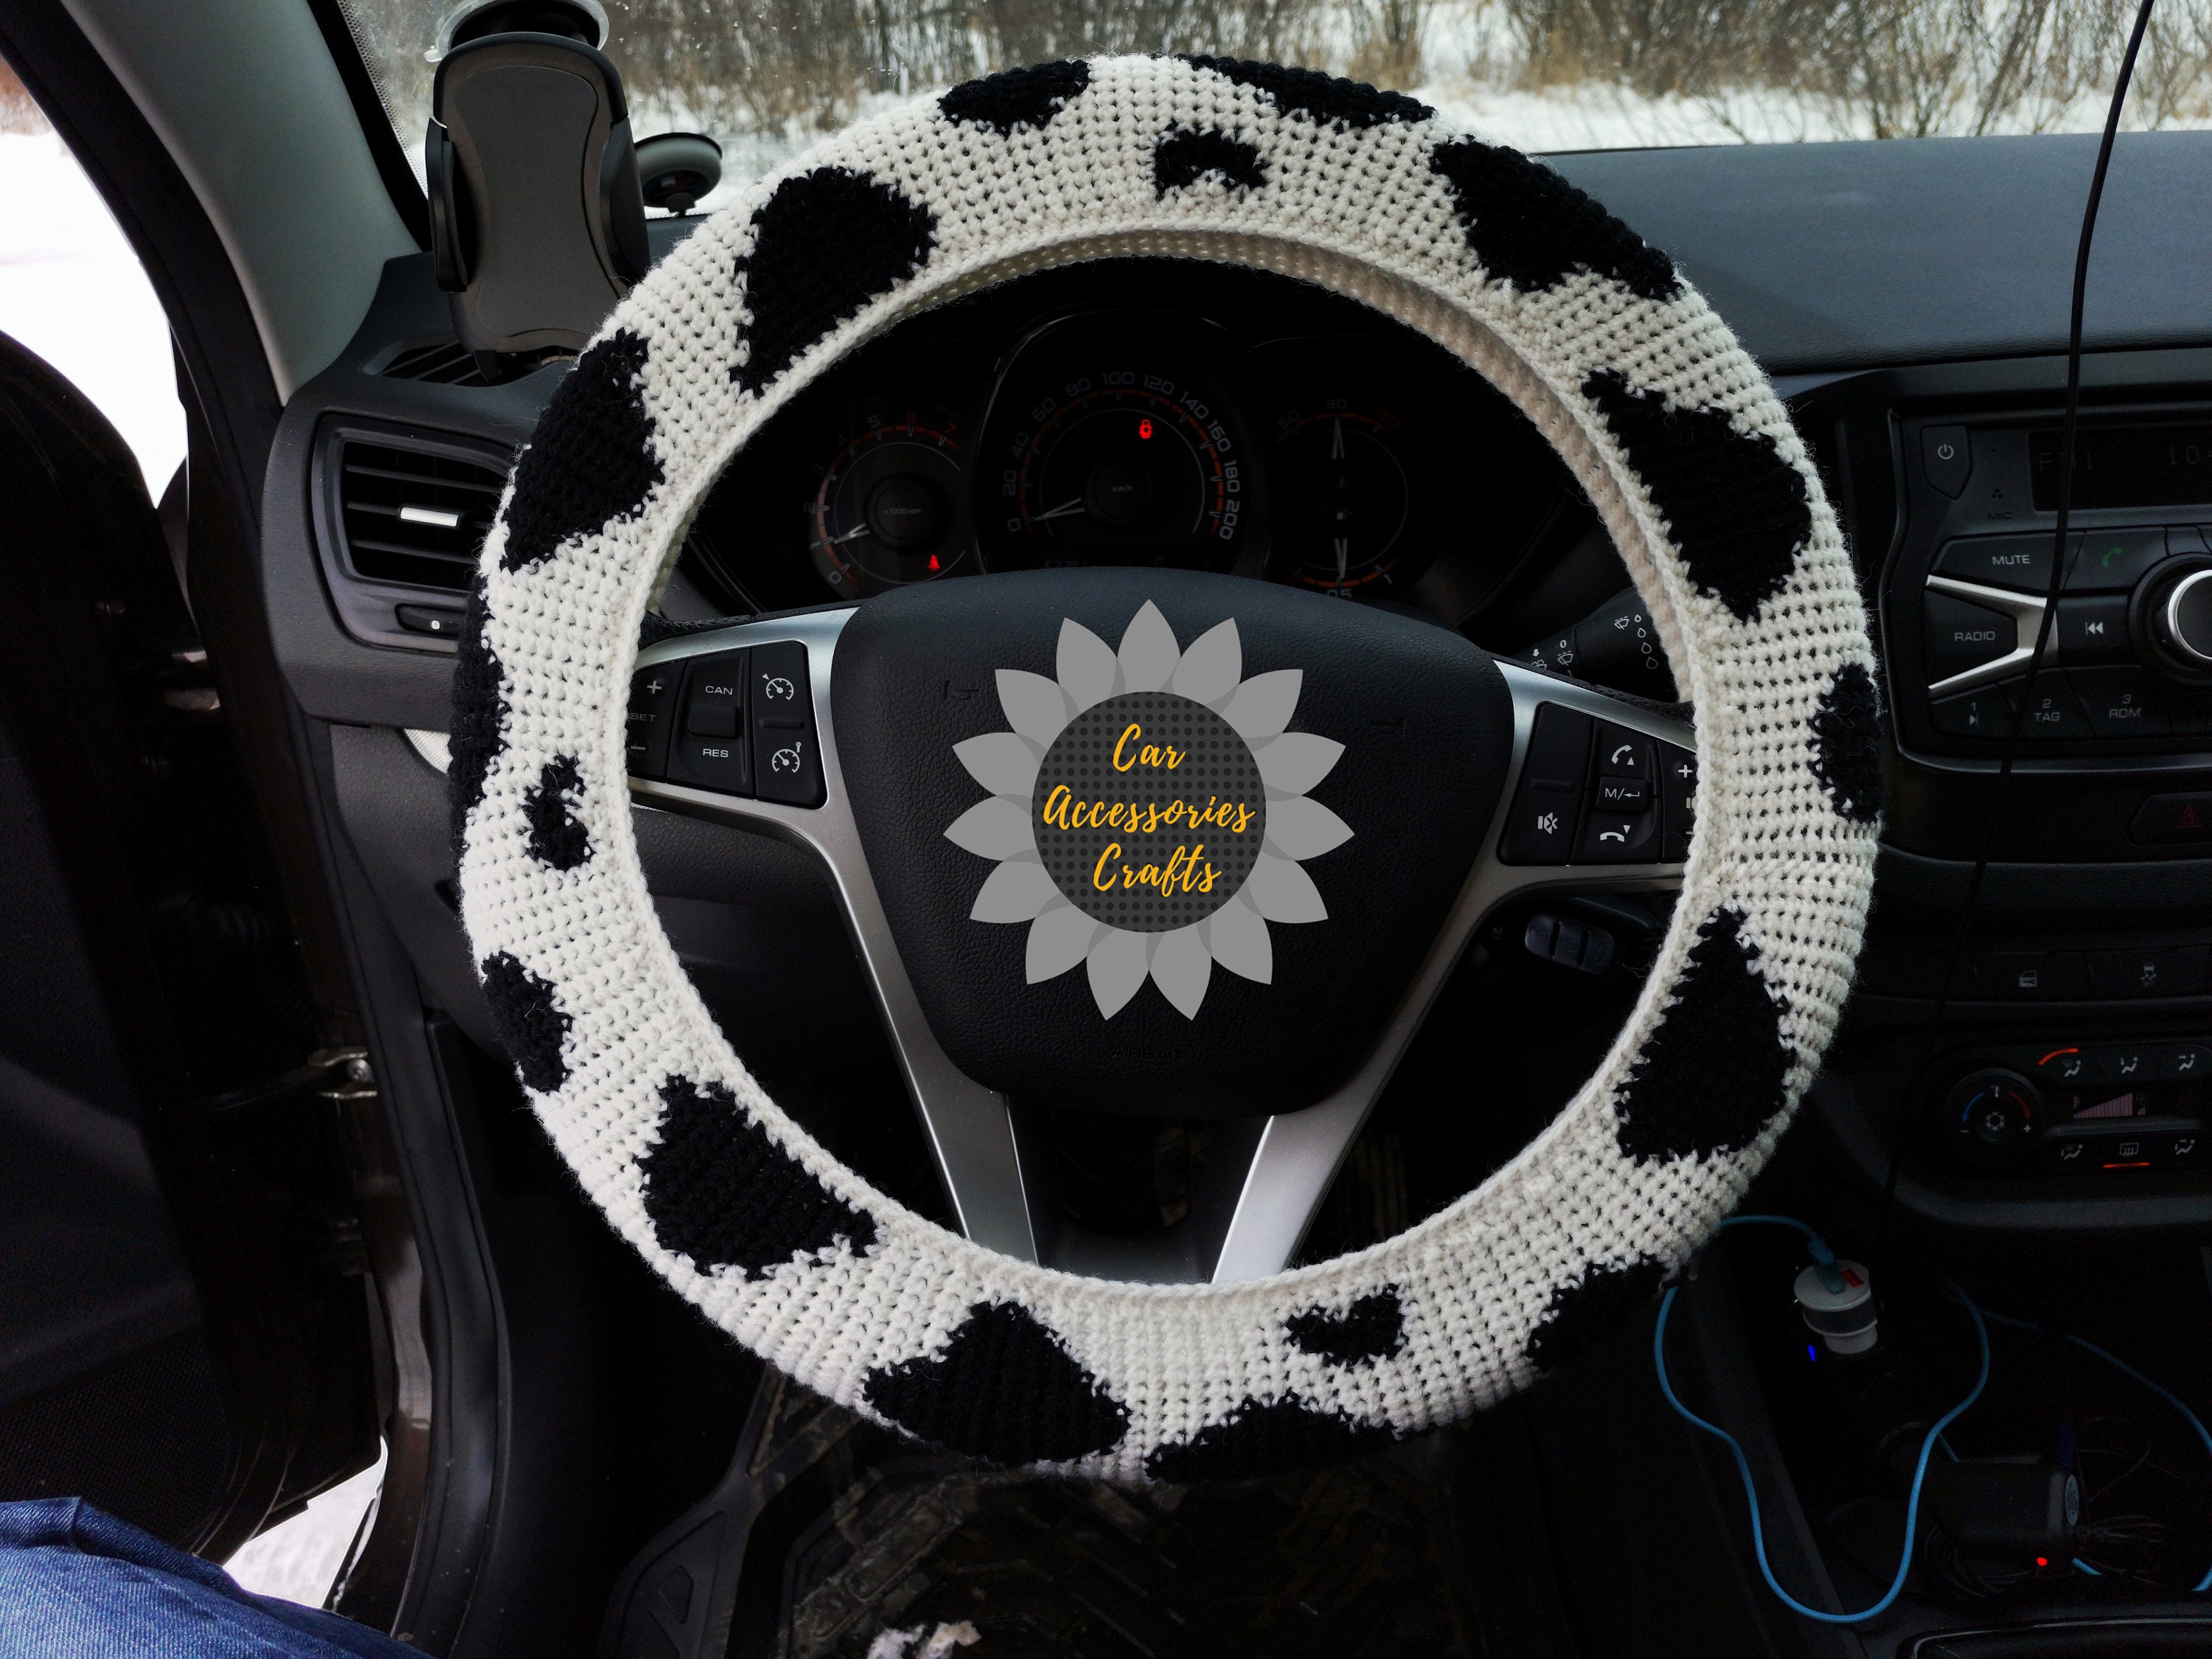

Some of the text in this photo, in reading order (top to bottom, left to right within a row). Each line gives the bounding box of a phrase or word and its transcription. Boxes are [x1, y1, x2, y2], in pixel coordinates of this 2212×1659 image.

[1102, 372, 1135, 385] 100
[1143, 374, 1175, 395] 120
[1065, 378, 1091, 398] 80
[1032, 397, 1057, 422] 60
[1179, 391, 1210, 420] 140
[868, 414, 880, 428] 5
[905, 411, 918, 423] 6
[945, 422, 958, 434] 7
[1206, 420, 1231, 453] 160
[1012, 431, 1030, 458] 40
[812, 464, 825, 476] 3
[1223, 459, 1240, 493] 180
[1003, 470, 1017, 495] 20
[1112, 484, 1133, 493] km/h
[1006, 518, 1021, 532] 0
[1219, 498, 1240, 540] 200
[1992, 554, 2031, 566] MUTE
[829, 571, 843, 585] 0
[1954, 631, 1996, 641] RADIO
[705, 686, 733, 695] CAN
[2042, 699, 2052, 709] 2
[2122, 694, 2132, 705] 3
[1969, 702, 1977, 712] 1
[630, 712, 656, 723] SET
[2034, 712, 2061, 723] TAG
[2109, 708, 2141, 719] RDM
[703, 748, 728, 758] RES
